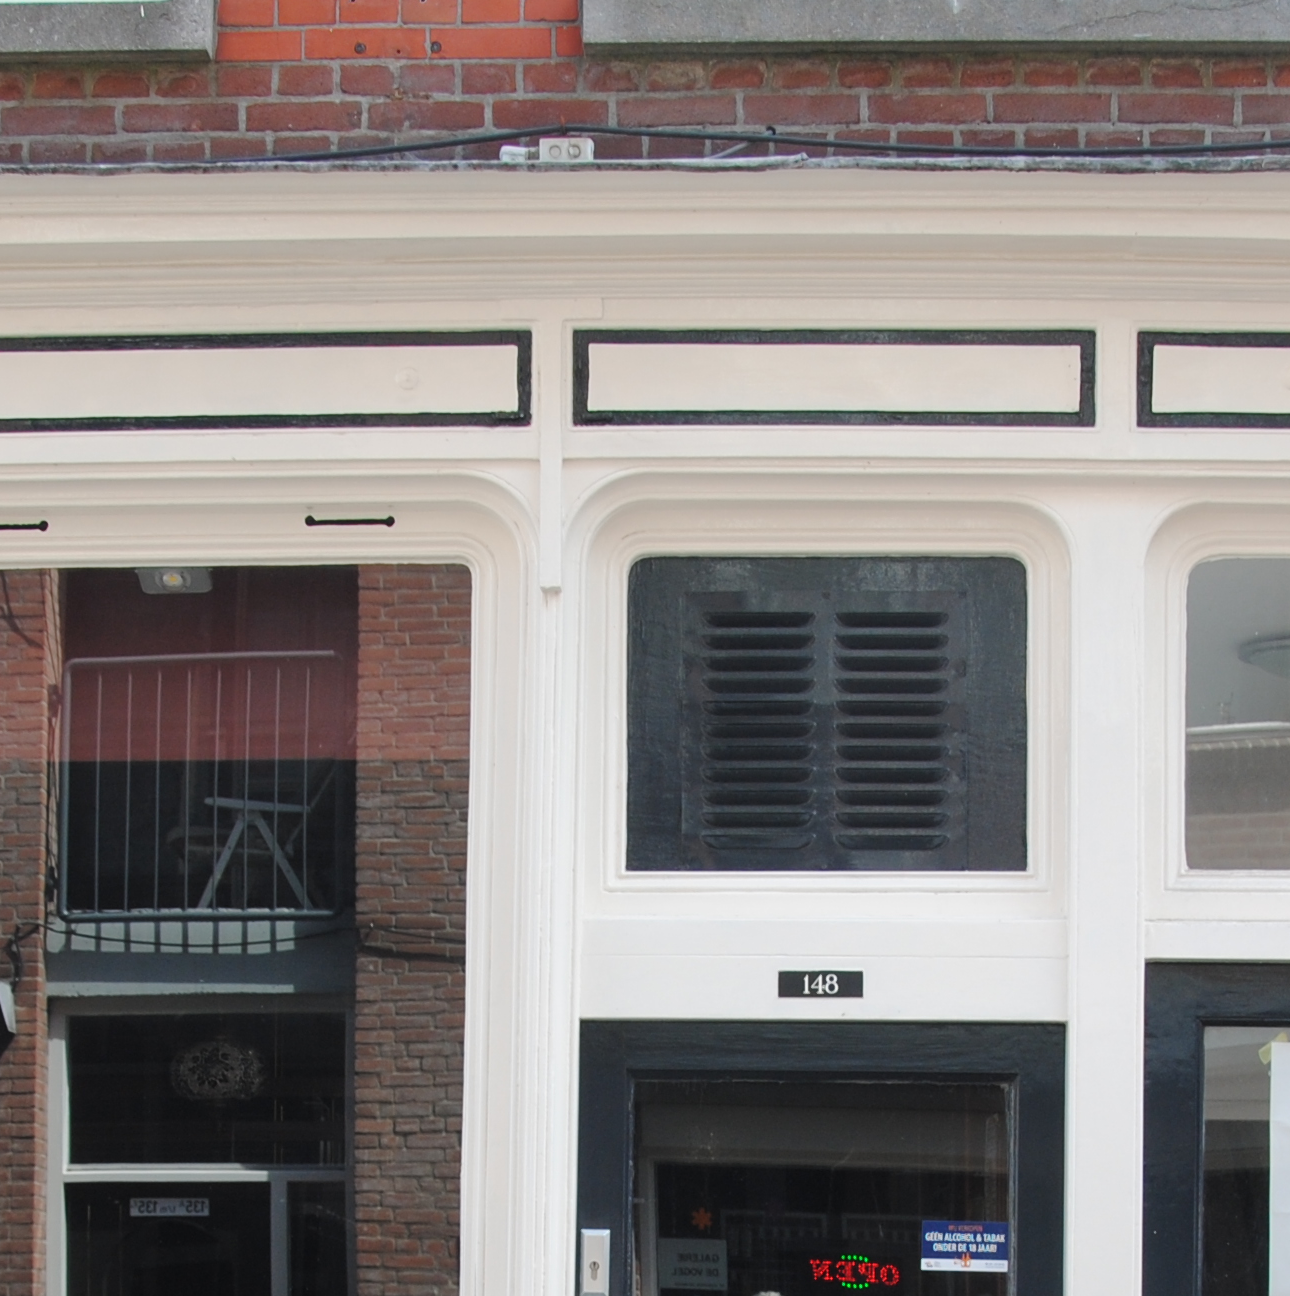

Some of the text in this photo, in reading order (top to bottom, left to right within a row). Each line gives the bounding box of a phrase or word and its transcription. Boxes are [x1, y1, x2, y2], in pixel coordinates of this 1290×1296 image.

[802, 974, 840, 995] 148
[944, 1233, 975, 1242] ALCOHOL
[983, 1233, 1006, 1243] TABAK
[932, 1243, 957, 1252] ONDER
[958, 1243, 967, 1252] DE
[969, 1243, 977, 1252] 18
